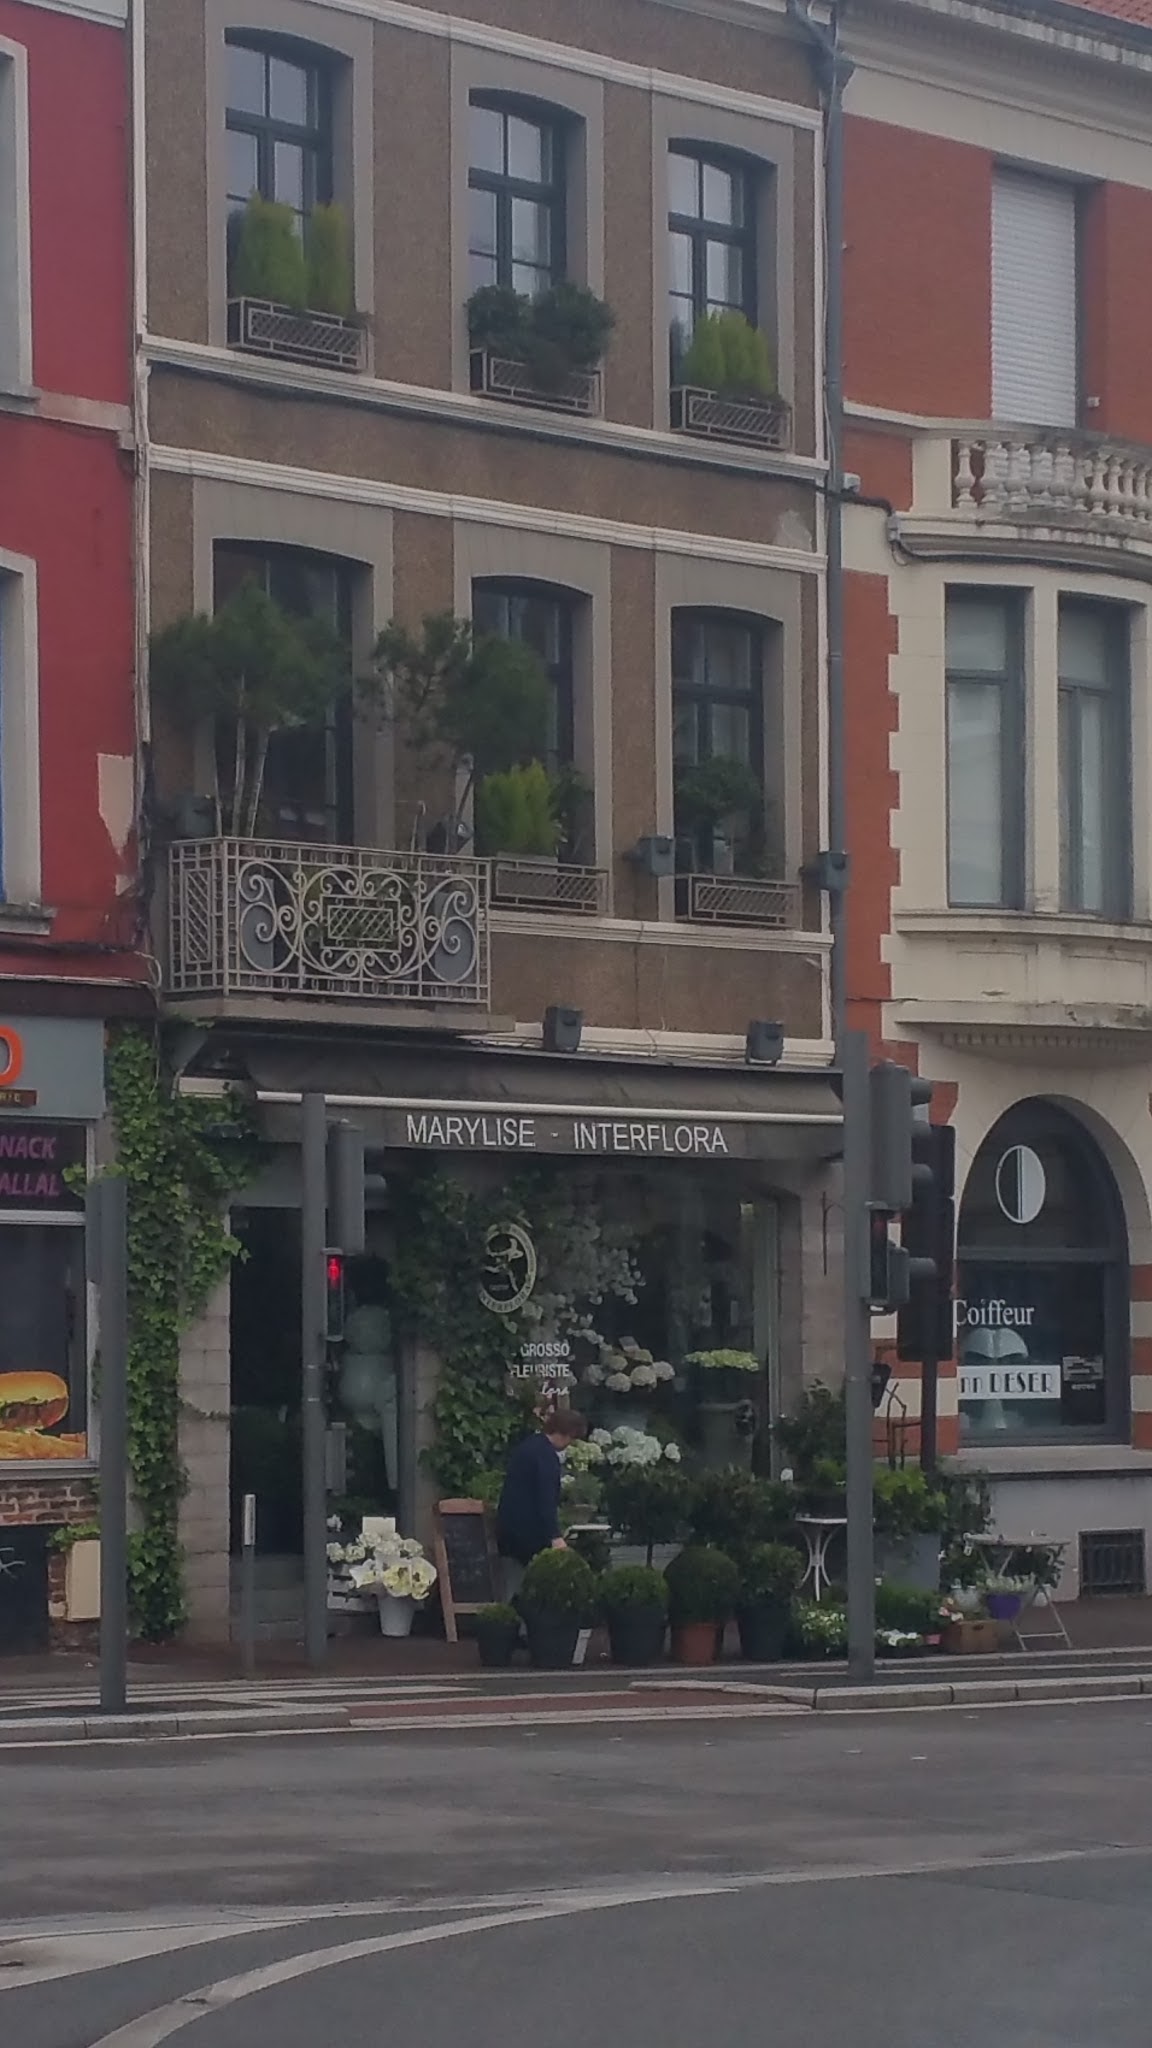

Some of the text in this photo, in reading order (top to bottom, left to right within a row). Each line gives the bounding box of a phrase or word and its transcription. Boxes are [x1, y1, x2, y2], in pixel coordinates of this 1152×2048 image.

[405, 1114, 536, 1148] MARYLISE
[573, 1121, 729, 1154] INTERFLORA
[0, 1134, 57, 1160] NACK
[520, 1342, 570, 1358] GROSSO
[510, 1363, 571, 1379] FLEURISTE
